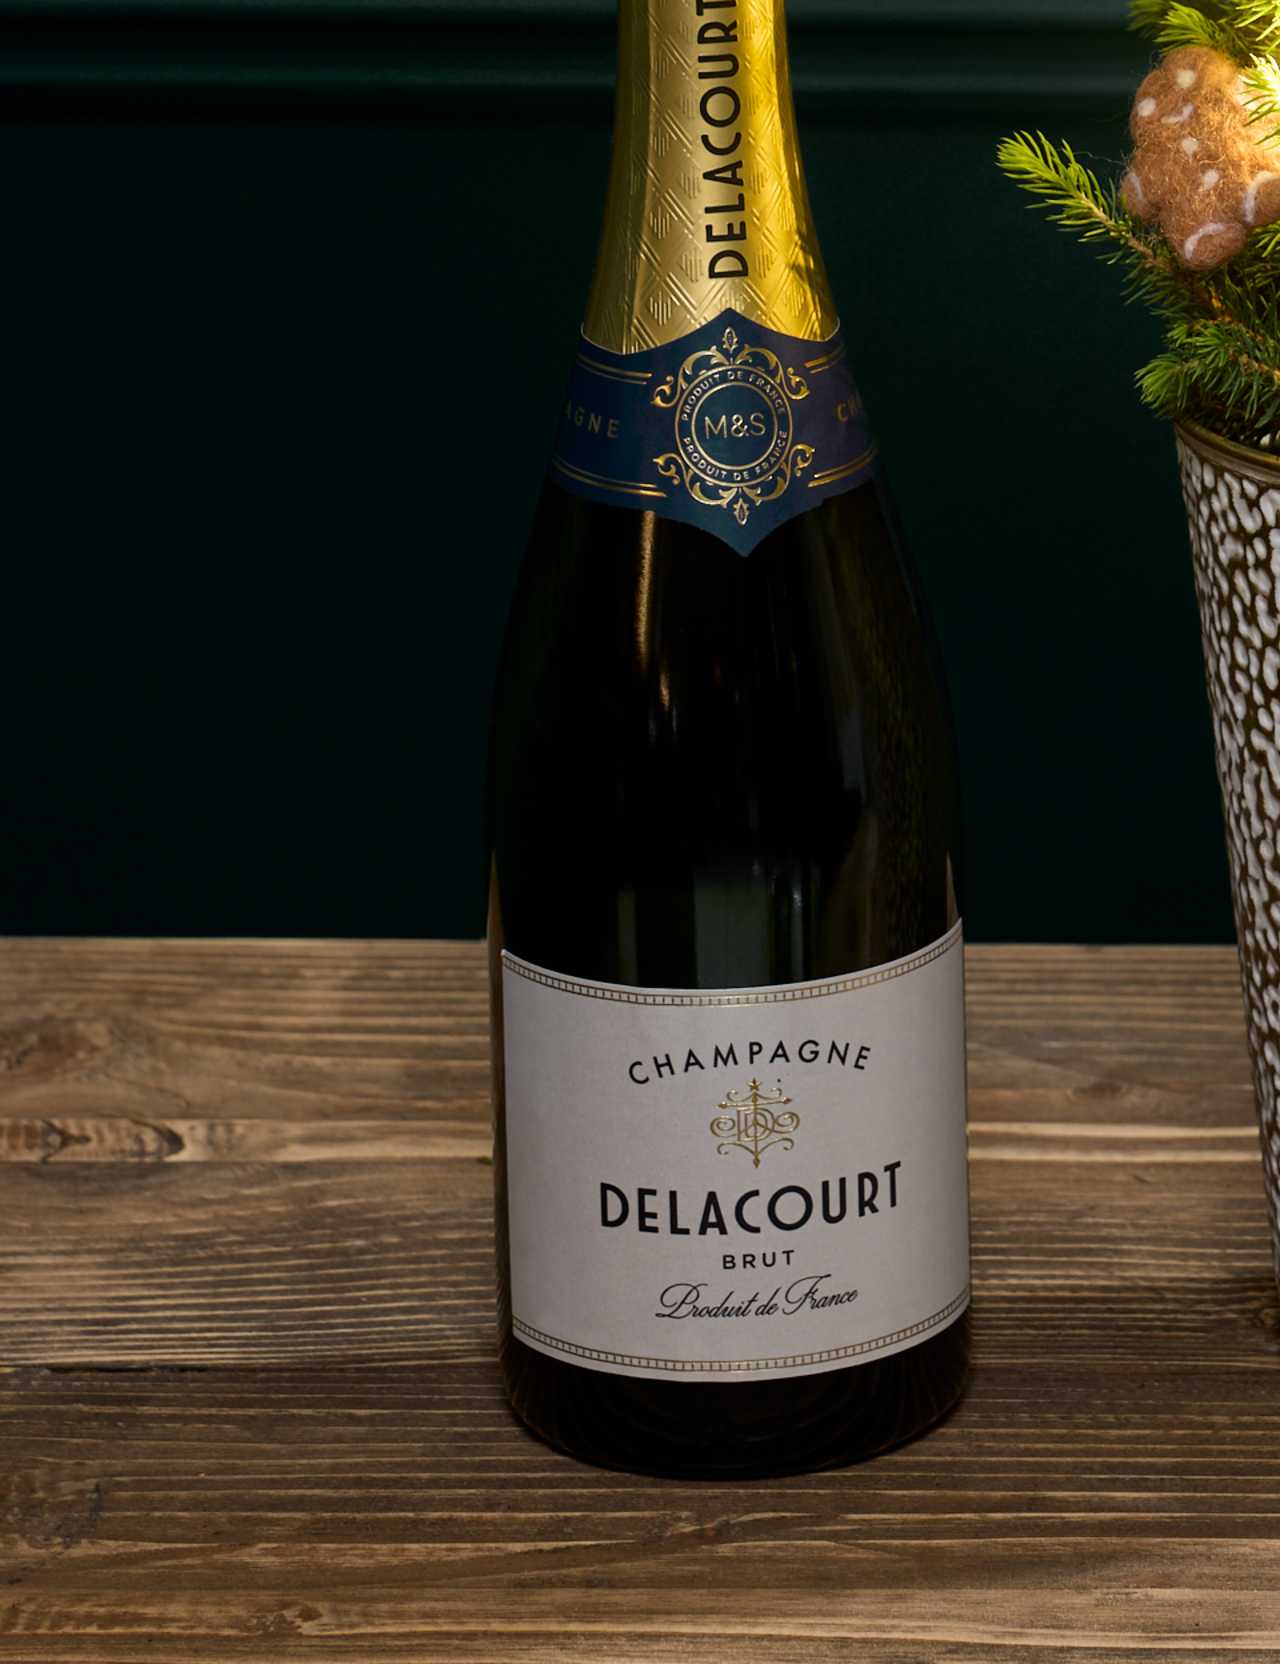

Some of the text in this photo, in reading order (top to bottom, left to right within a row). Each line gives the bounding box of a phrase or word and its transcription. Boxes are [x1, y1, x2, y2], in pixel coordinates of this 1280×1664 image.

[681, 374, 720, 421] PRODUIT
[727, 370, 744, 380] DE
[704, 412, 766, 440] M&S
[682, 436, 727, 479] PRODUIT
[733, 471, 750, 482] DE
[628, 1039, 871, 1085] CHAMPAGNE
[600, 1161, 902, 1236] DELACOURT
[722, 1250, 795, 1270] BRUT
[655, 1274, 858, 1319] Produit de France
